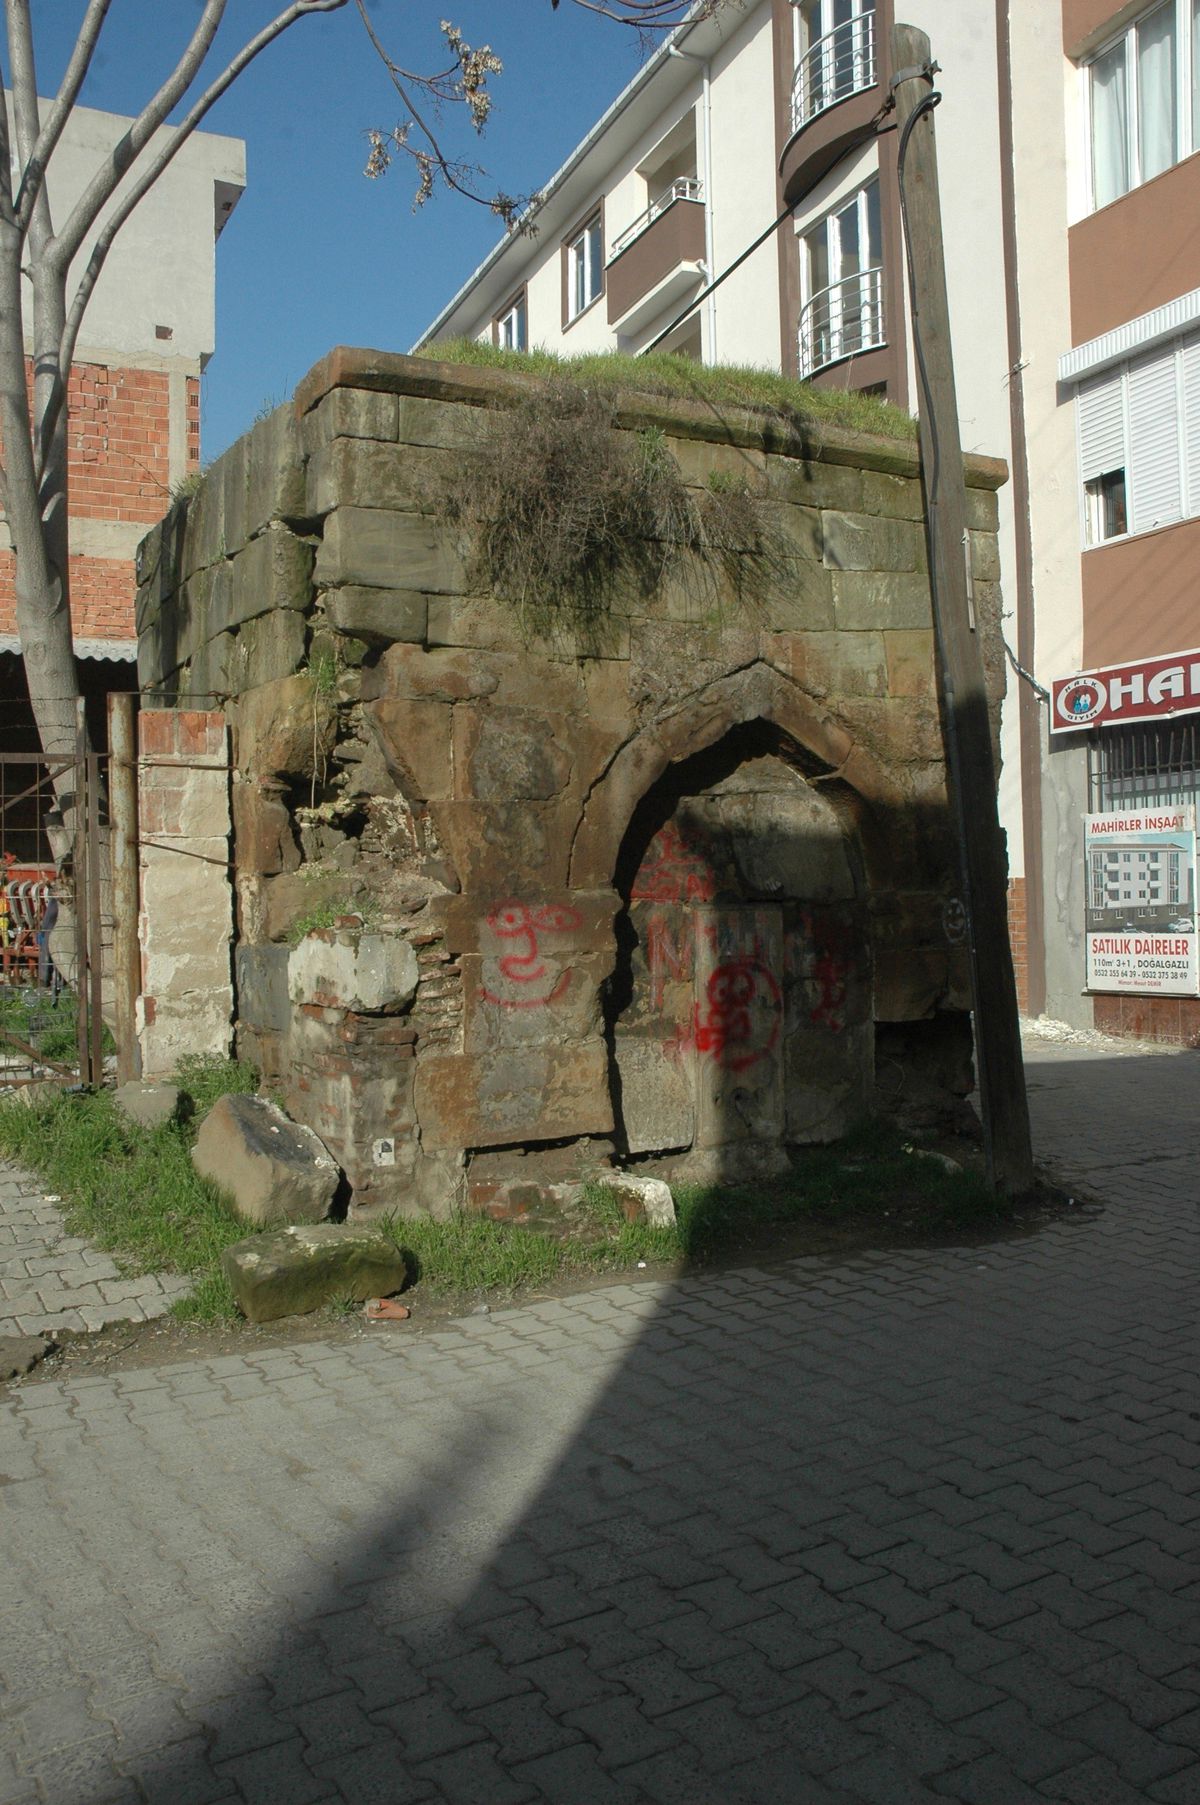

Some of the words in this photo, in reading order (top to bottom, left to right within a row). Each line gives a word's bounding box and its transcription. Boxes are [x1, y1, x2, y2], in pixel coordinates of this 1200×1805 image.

[1064, 680, 1097, 693] HALK
[1091, 818, 1142, 833] MAHİRLER
[1145, 816, 1185, 832] İNŞAAT
[1092, 938, 1131, 955] SATILIK
[1135, 935, 1189, 956] DAİRELER
[1137, 957, 1189, 969] DOĞALGAZLI
[1094, 969, 1108, 977] 0532
[1142, 971, 1157, 979] 0532
